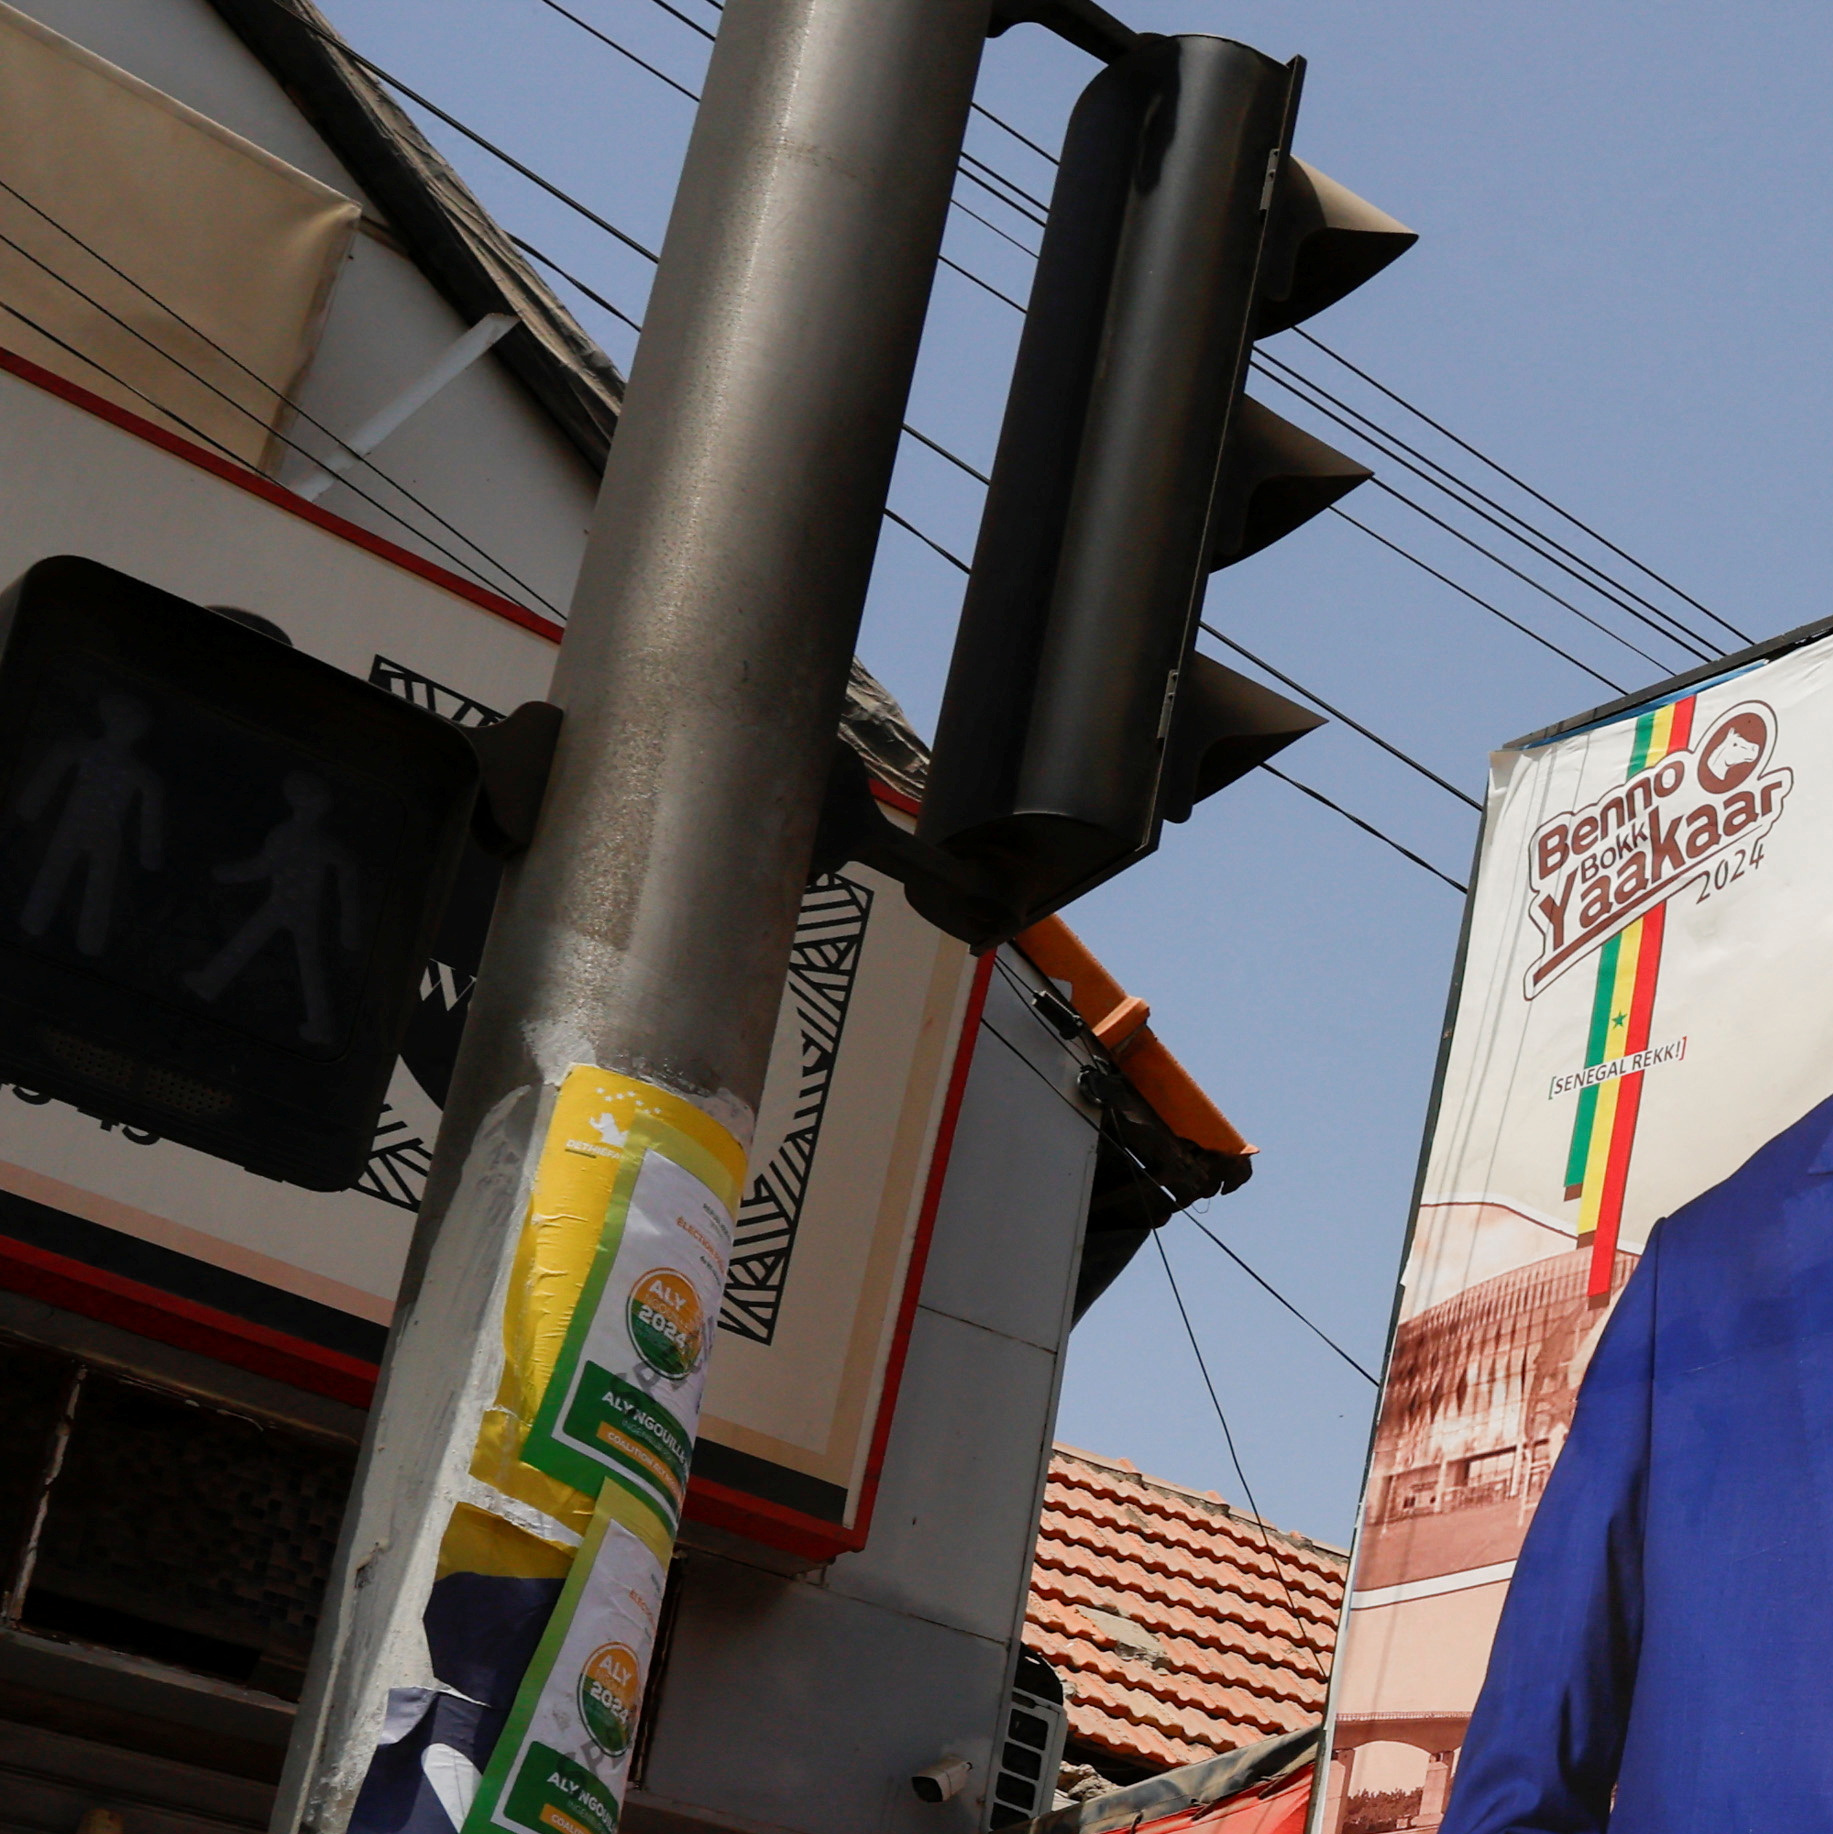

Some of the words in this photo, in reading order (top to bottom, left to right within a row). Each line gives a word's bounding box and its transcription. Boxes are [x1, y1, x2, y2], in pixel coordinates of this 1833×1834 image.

[1536, 761, 1686, 880] Benno
[1540, 780, 1782, 951] Yaakaar
[1696, 840, 1765, 905] 2024
[638, 1304, 691, 1348] 2024
[648, 1279, 687, 1312] ALY
[602, 1390, 632, 1417] ALY
[632, 1405, 688, 1466] NGOUILL
[600, 1654, 633, 1686] ALY
[590, 1680, 629, 1728] 2024
[546, 1771, 579, 1795] ALY
[578, 1786, 619, 1834] NGOUILL
